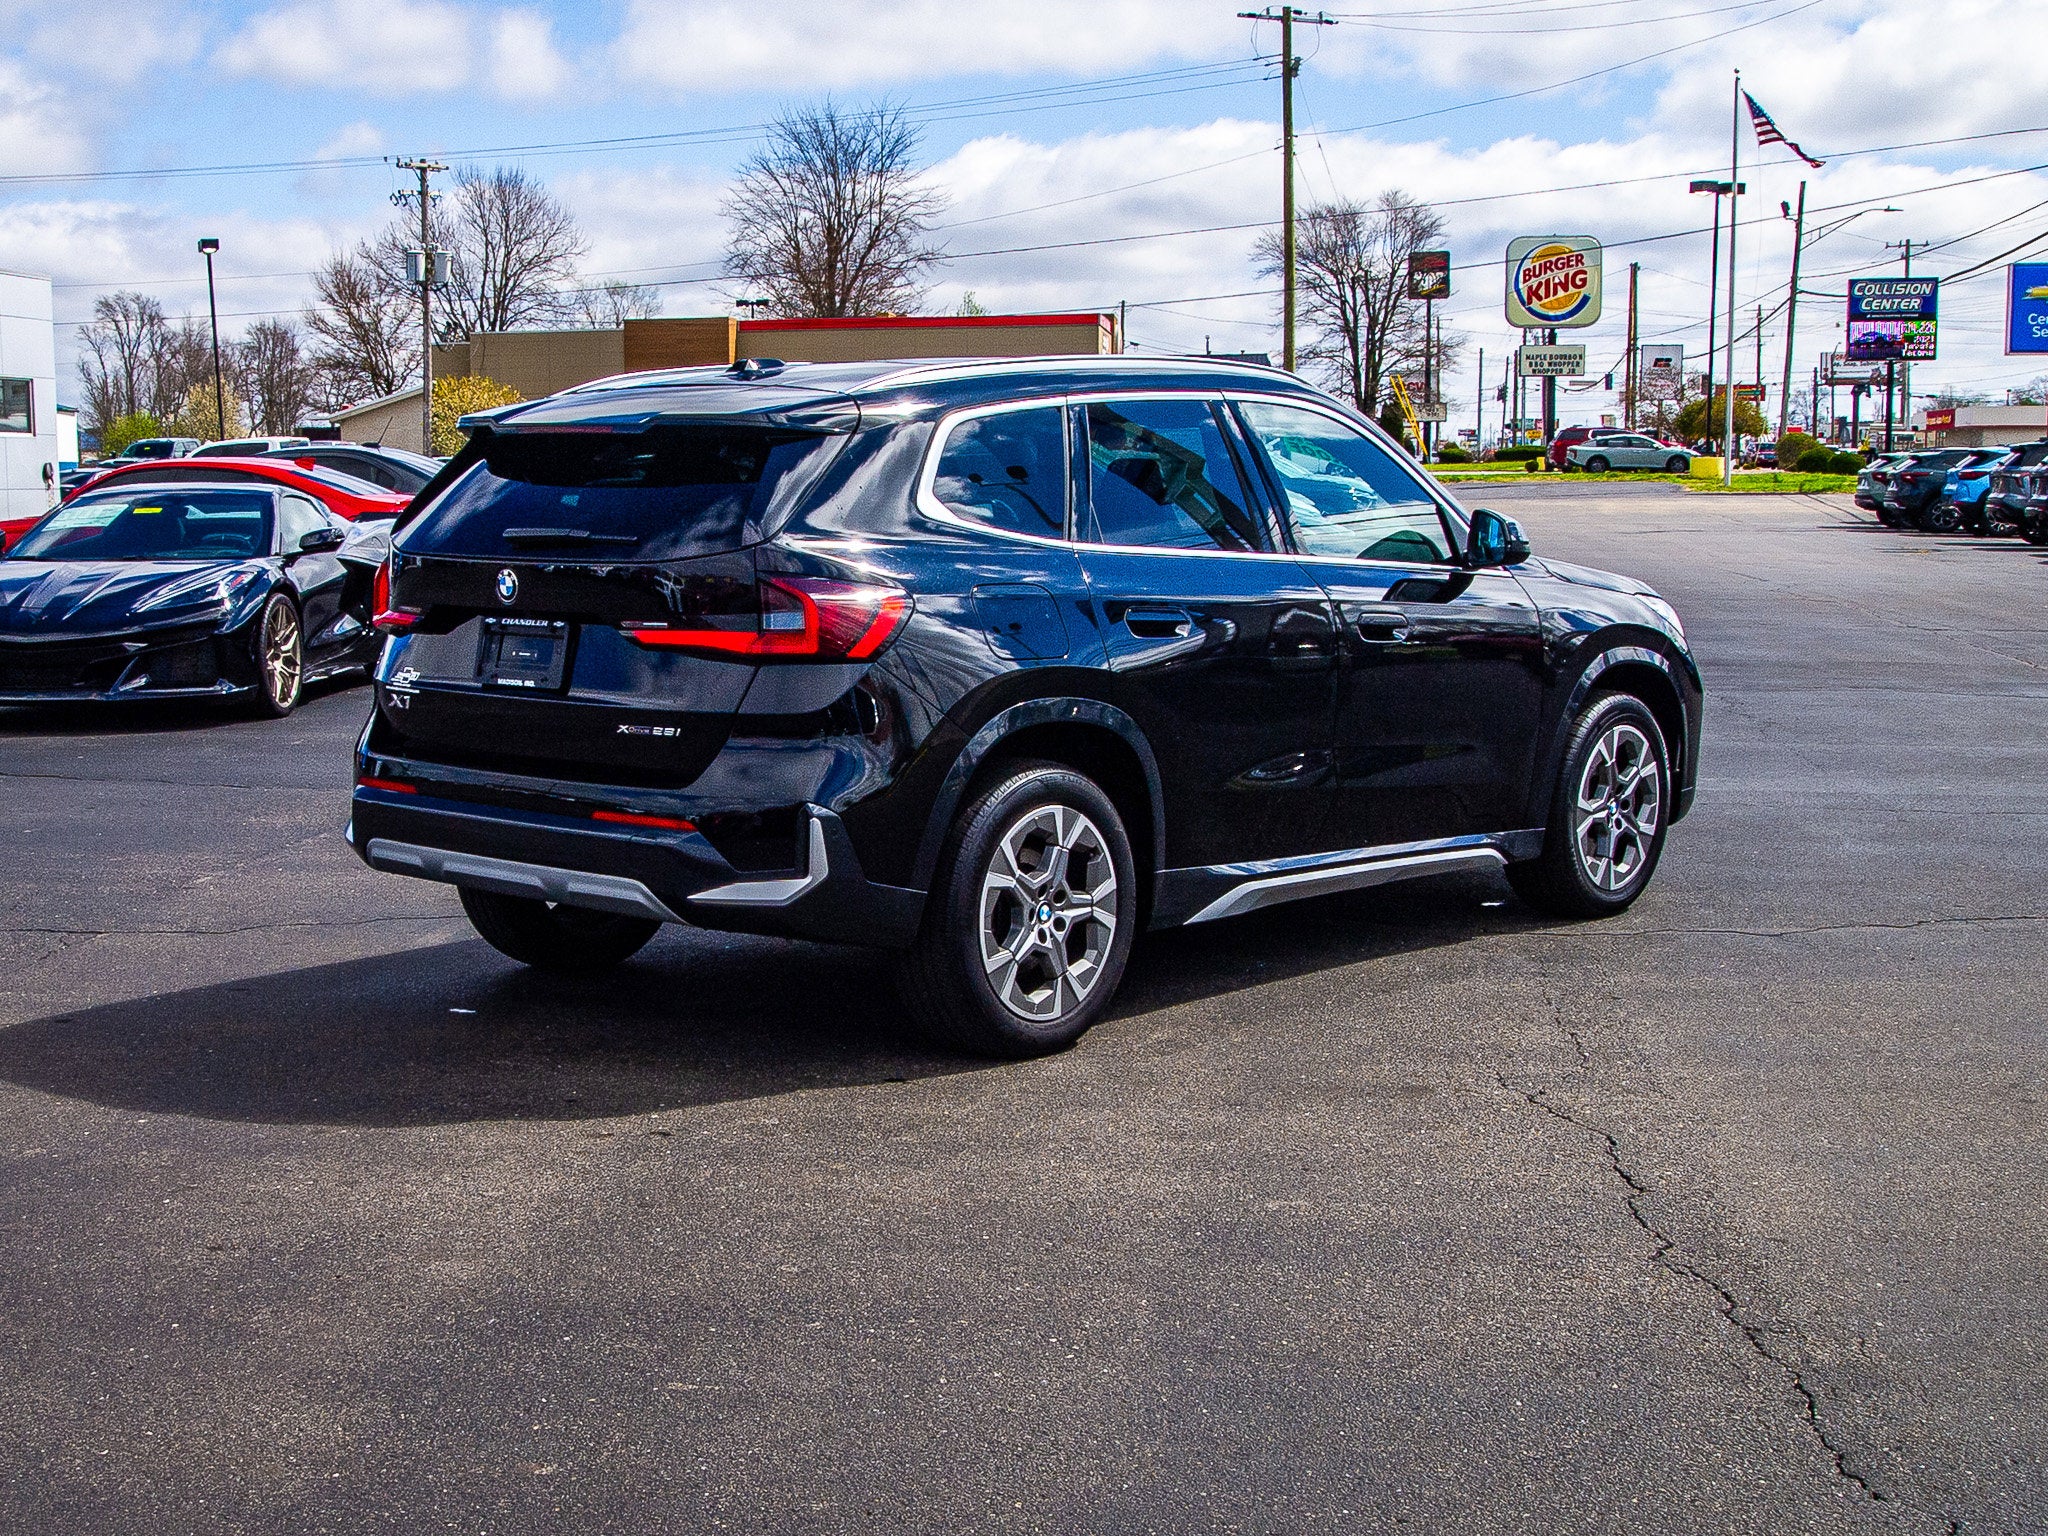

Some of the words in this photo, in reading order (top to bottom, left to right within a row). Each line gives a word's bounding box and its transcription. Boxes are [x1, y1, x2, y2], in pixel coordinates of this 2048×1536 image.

[1523, 253, 1585, 284] BURGER
[1526, 269, 1588, 306] KING
[1853, 282, 1932, 295] COLLISION
[1861, 297, 1921, 310] CENTER
[501, 618, 548, 627] CHANDLER
[389, 693, 411, 709] X1
